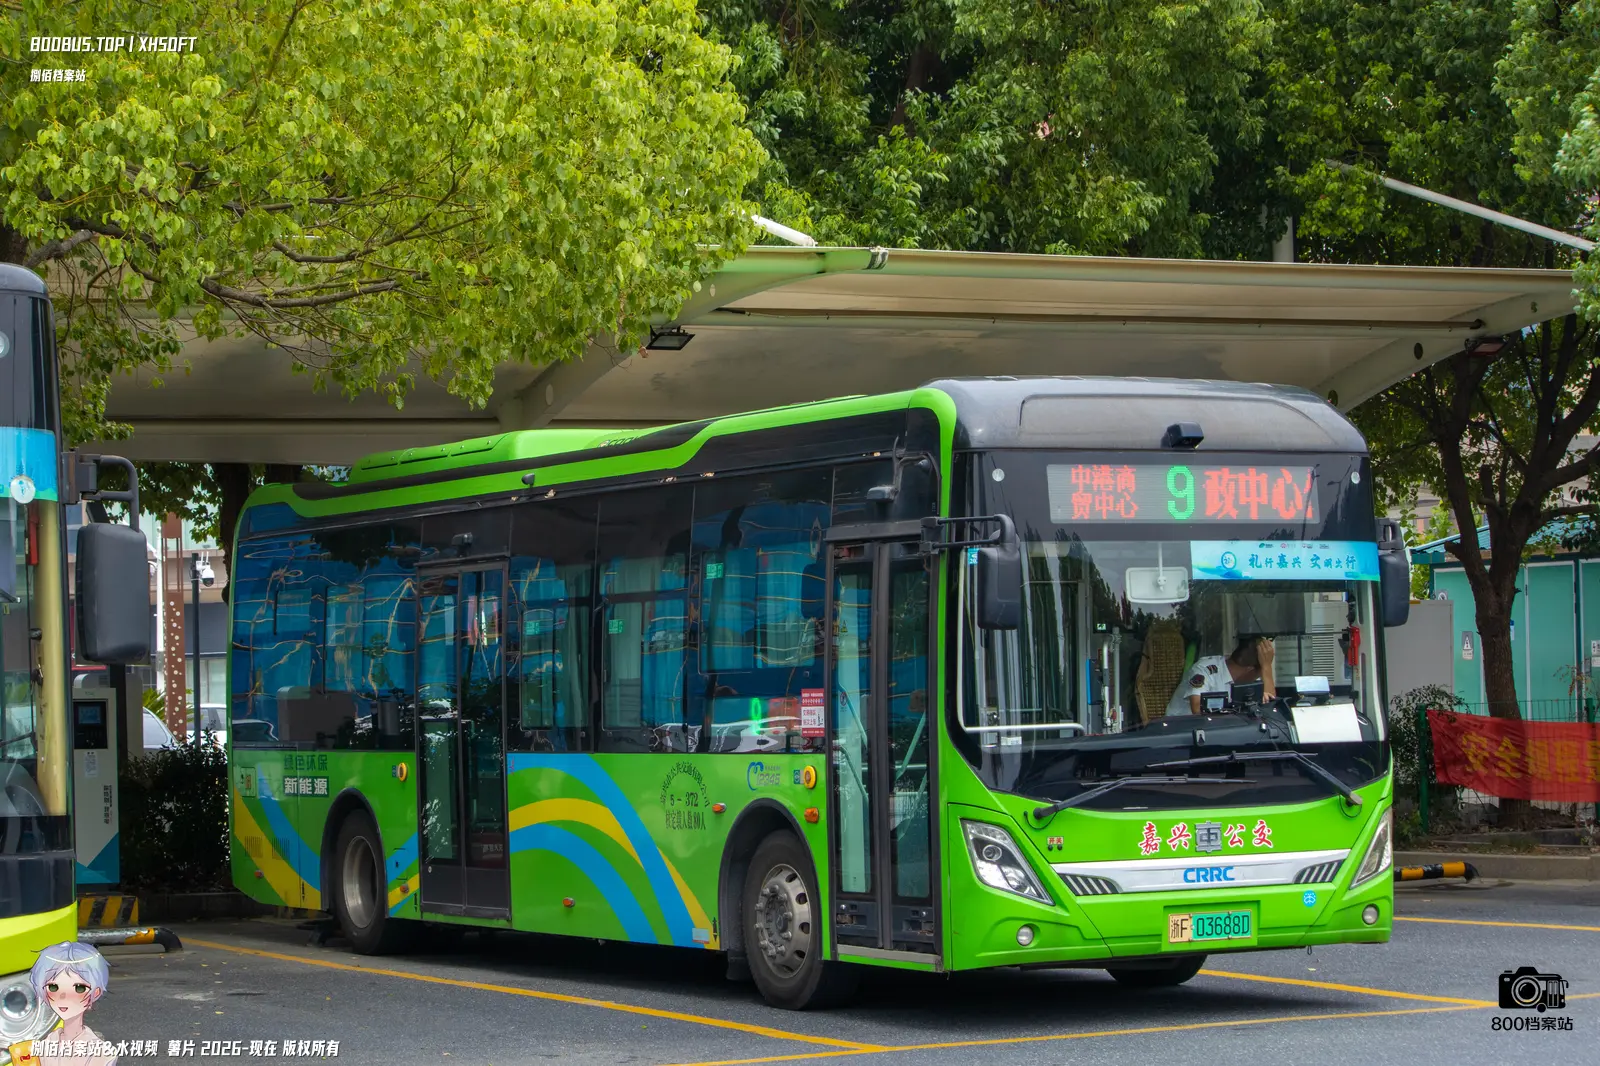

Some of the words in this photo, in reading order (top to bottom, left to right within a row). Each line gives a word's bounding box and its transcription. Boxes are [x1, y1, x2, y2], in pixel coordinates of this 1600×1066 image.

[1166, 465, 1195, 520] 9
[284, 777, 328, 795] 新能源
[1138, 821, 1191, 855] 嘉兴
[1224, 820, 1273, 848] 公交
[1183, 866, 1236, 884] CRRC
